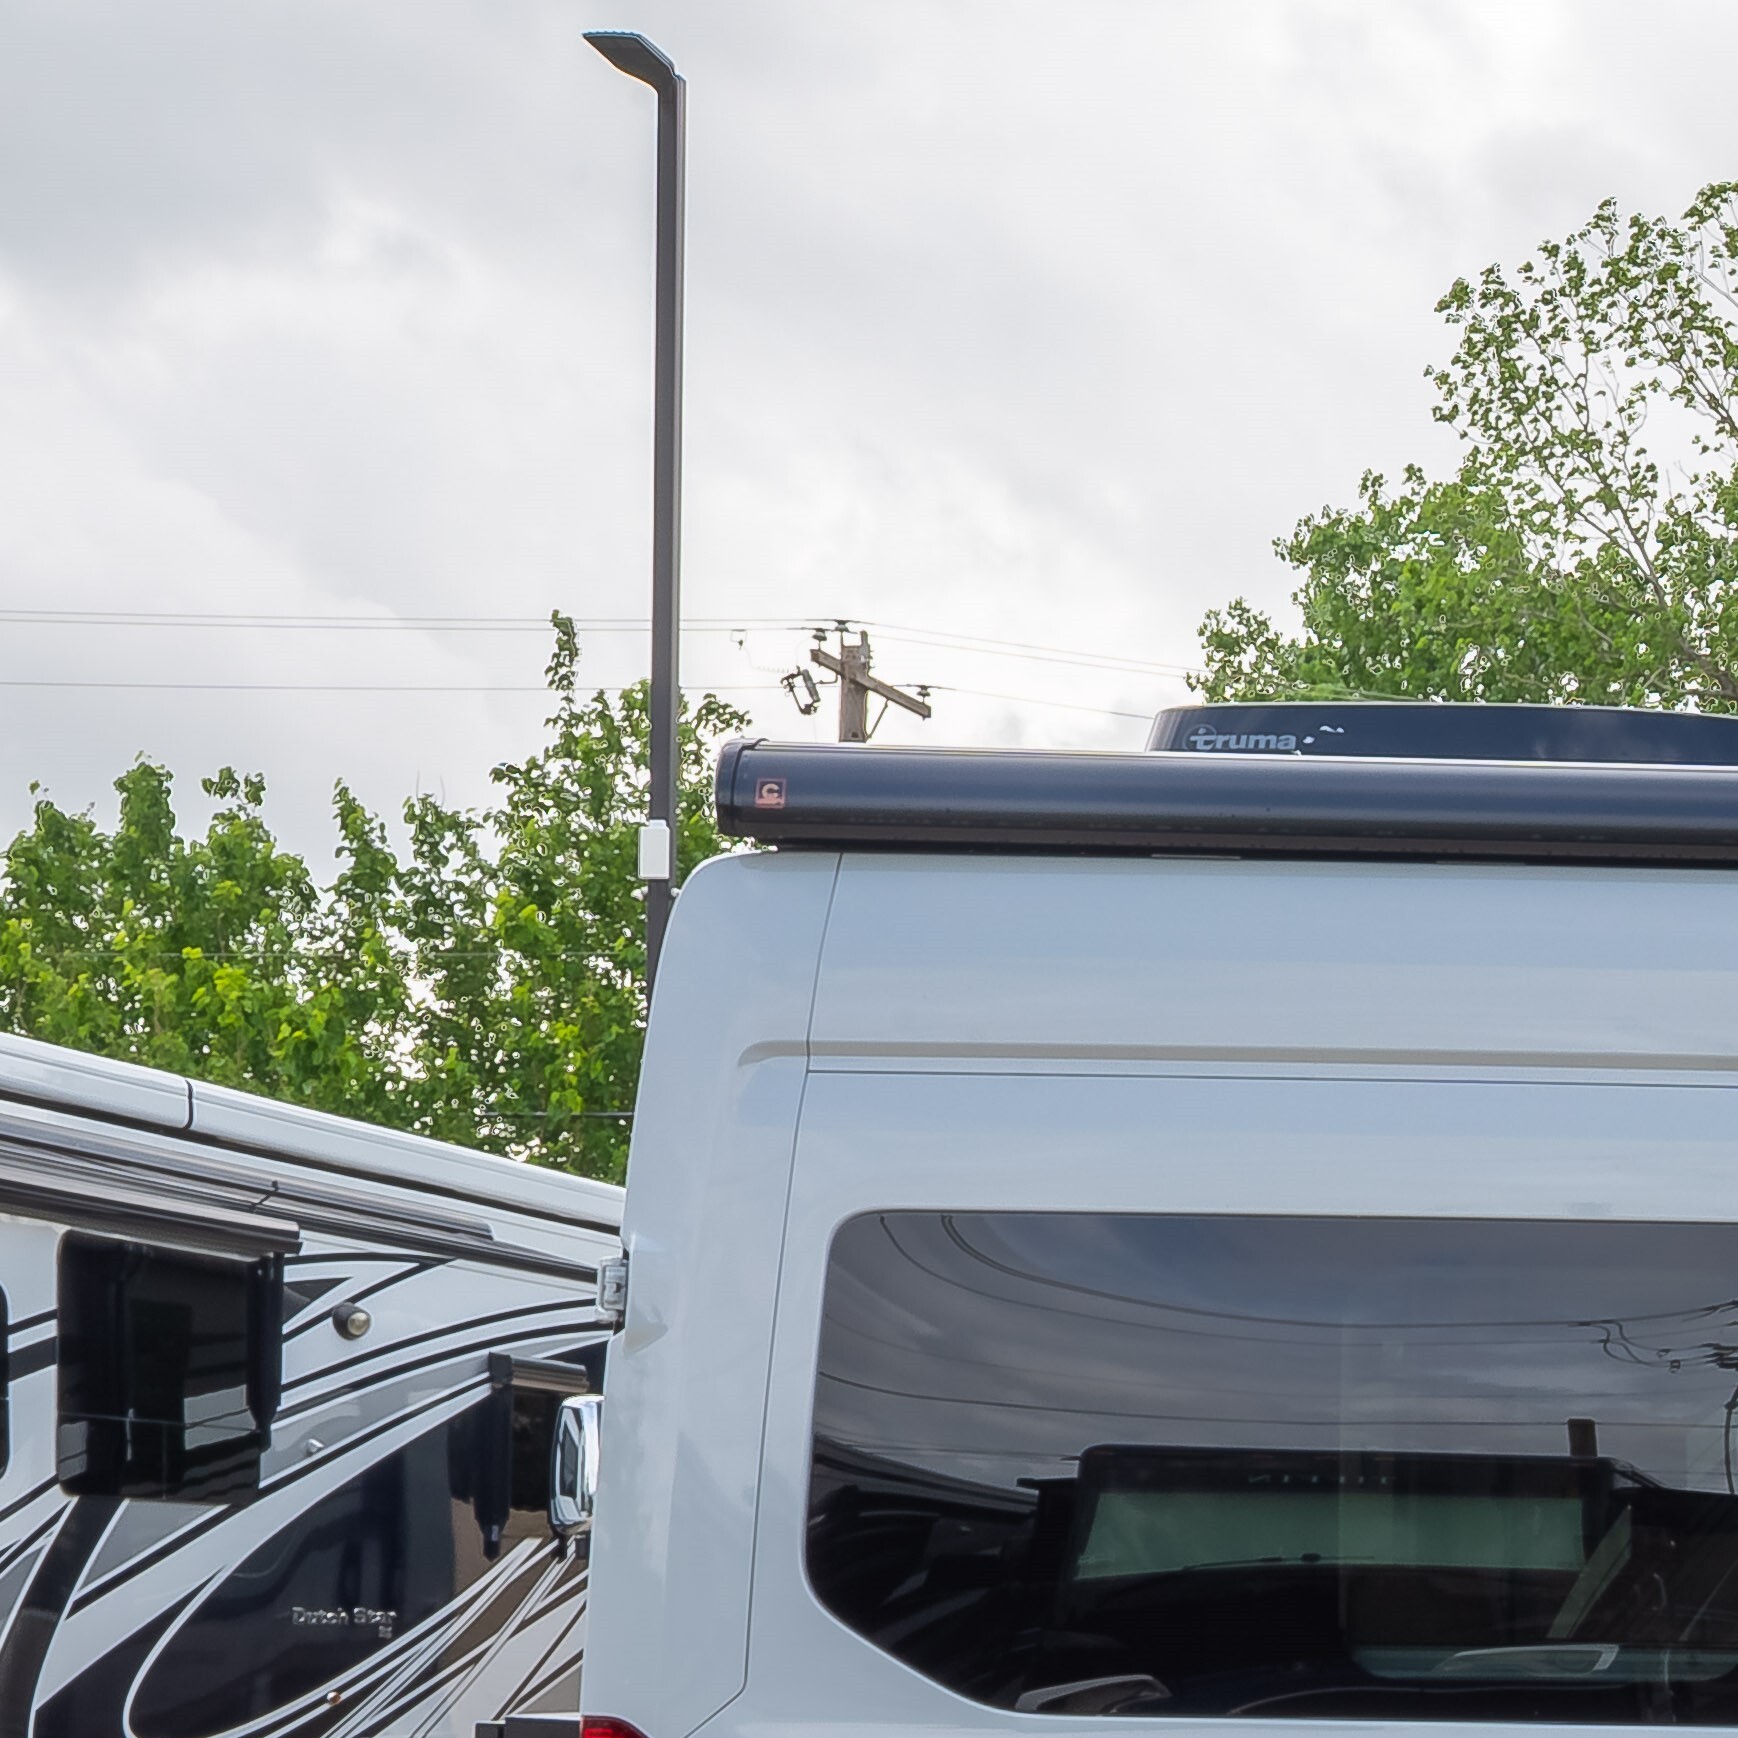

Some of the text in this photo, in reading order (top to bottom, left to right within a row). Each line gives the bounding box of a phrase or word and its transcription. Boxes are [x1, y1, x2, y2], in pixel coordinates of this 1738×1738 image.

[1189, 728, 1297, 750] truma
[292, 1606, 396, 1625] Dutch Star
